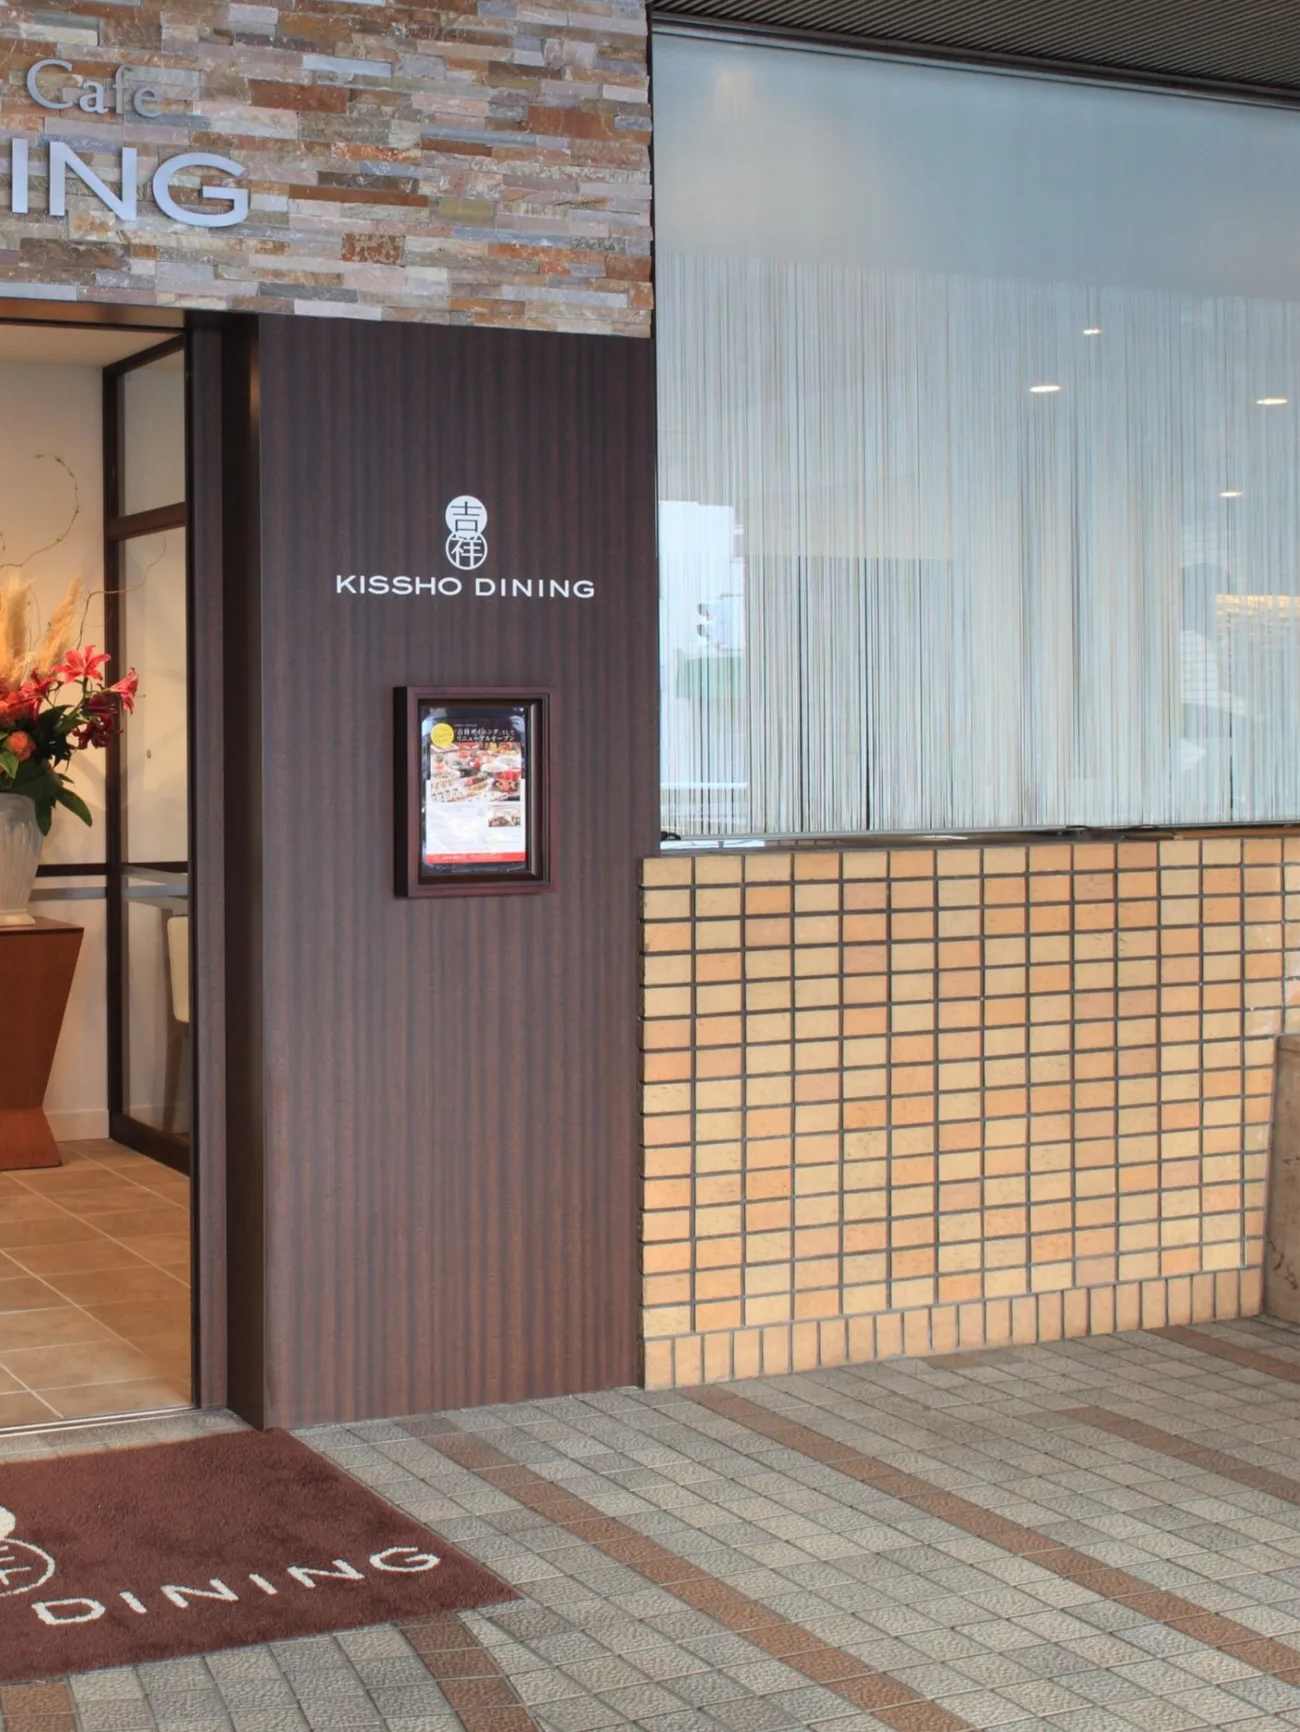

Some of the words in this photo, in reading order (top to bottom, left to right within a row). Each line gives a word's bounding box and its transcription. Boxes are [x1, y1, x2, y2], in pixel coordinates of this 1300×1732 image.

[450, 500, 483, 568] 吉祥
[337, 575, 462, 596] KISSHO
[475, 578, 595, 599] DINING
[31, 1546, 441, 1626] DINING
